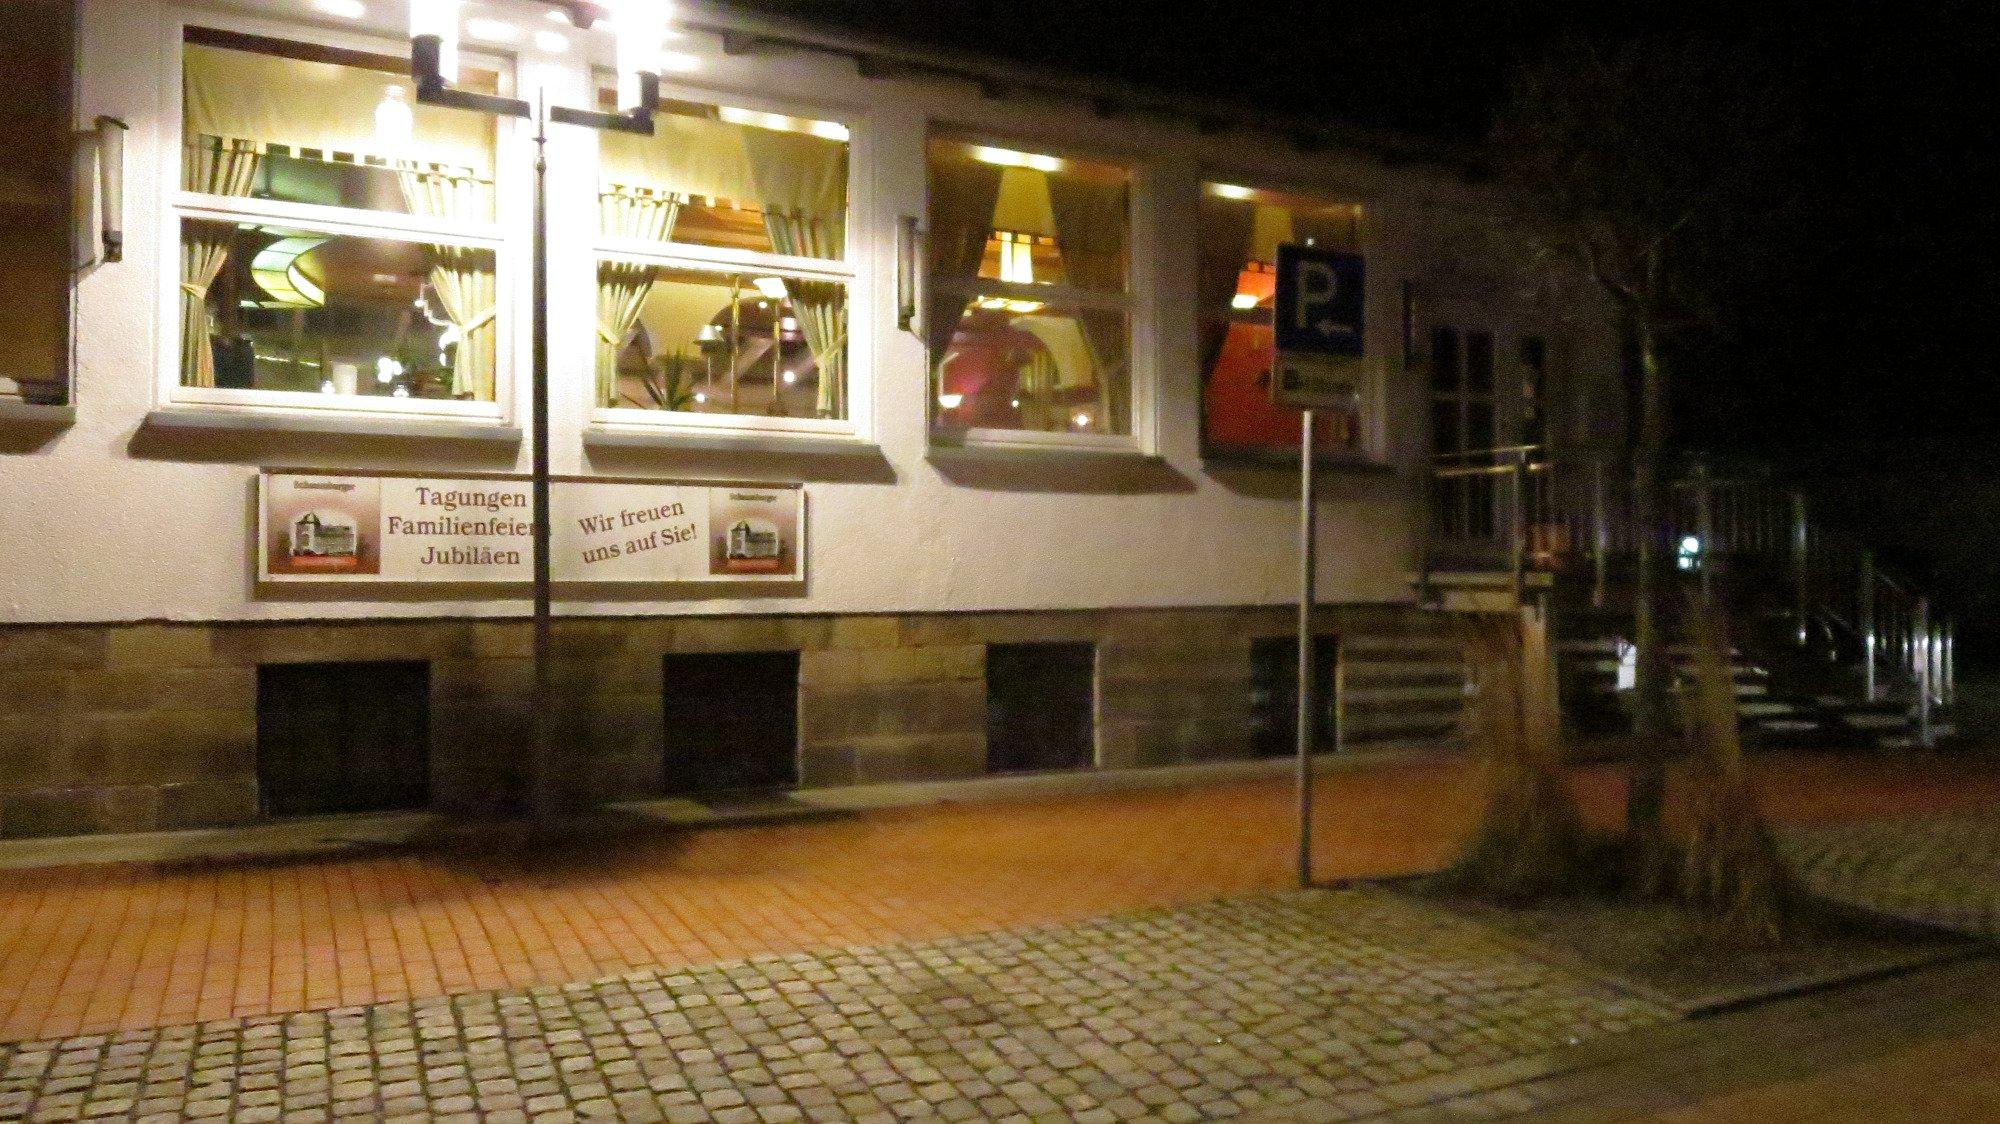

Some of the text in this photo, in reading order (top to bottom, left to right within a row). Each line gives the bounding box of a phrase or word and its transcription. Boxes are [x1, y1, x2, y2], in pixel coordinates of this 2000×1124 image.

[1296, 258, 1337, 329] P
[415, 487, 528, 512] Tagungen
[388, 516, 552, 536] Familienfeier
[578, 502, 685, 535] Wir freuen
[420, 546, 521, 566] Jubiläen
[582, 522, 698, 564] uns auf Sie!
